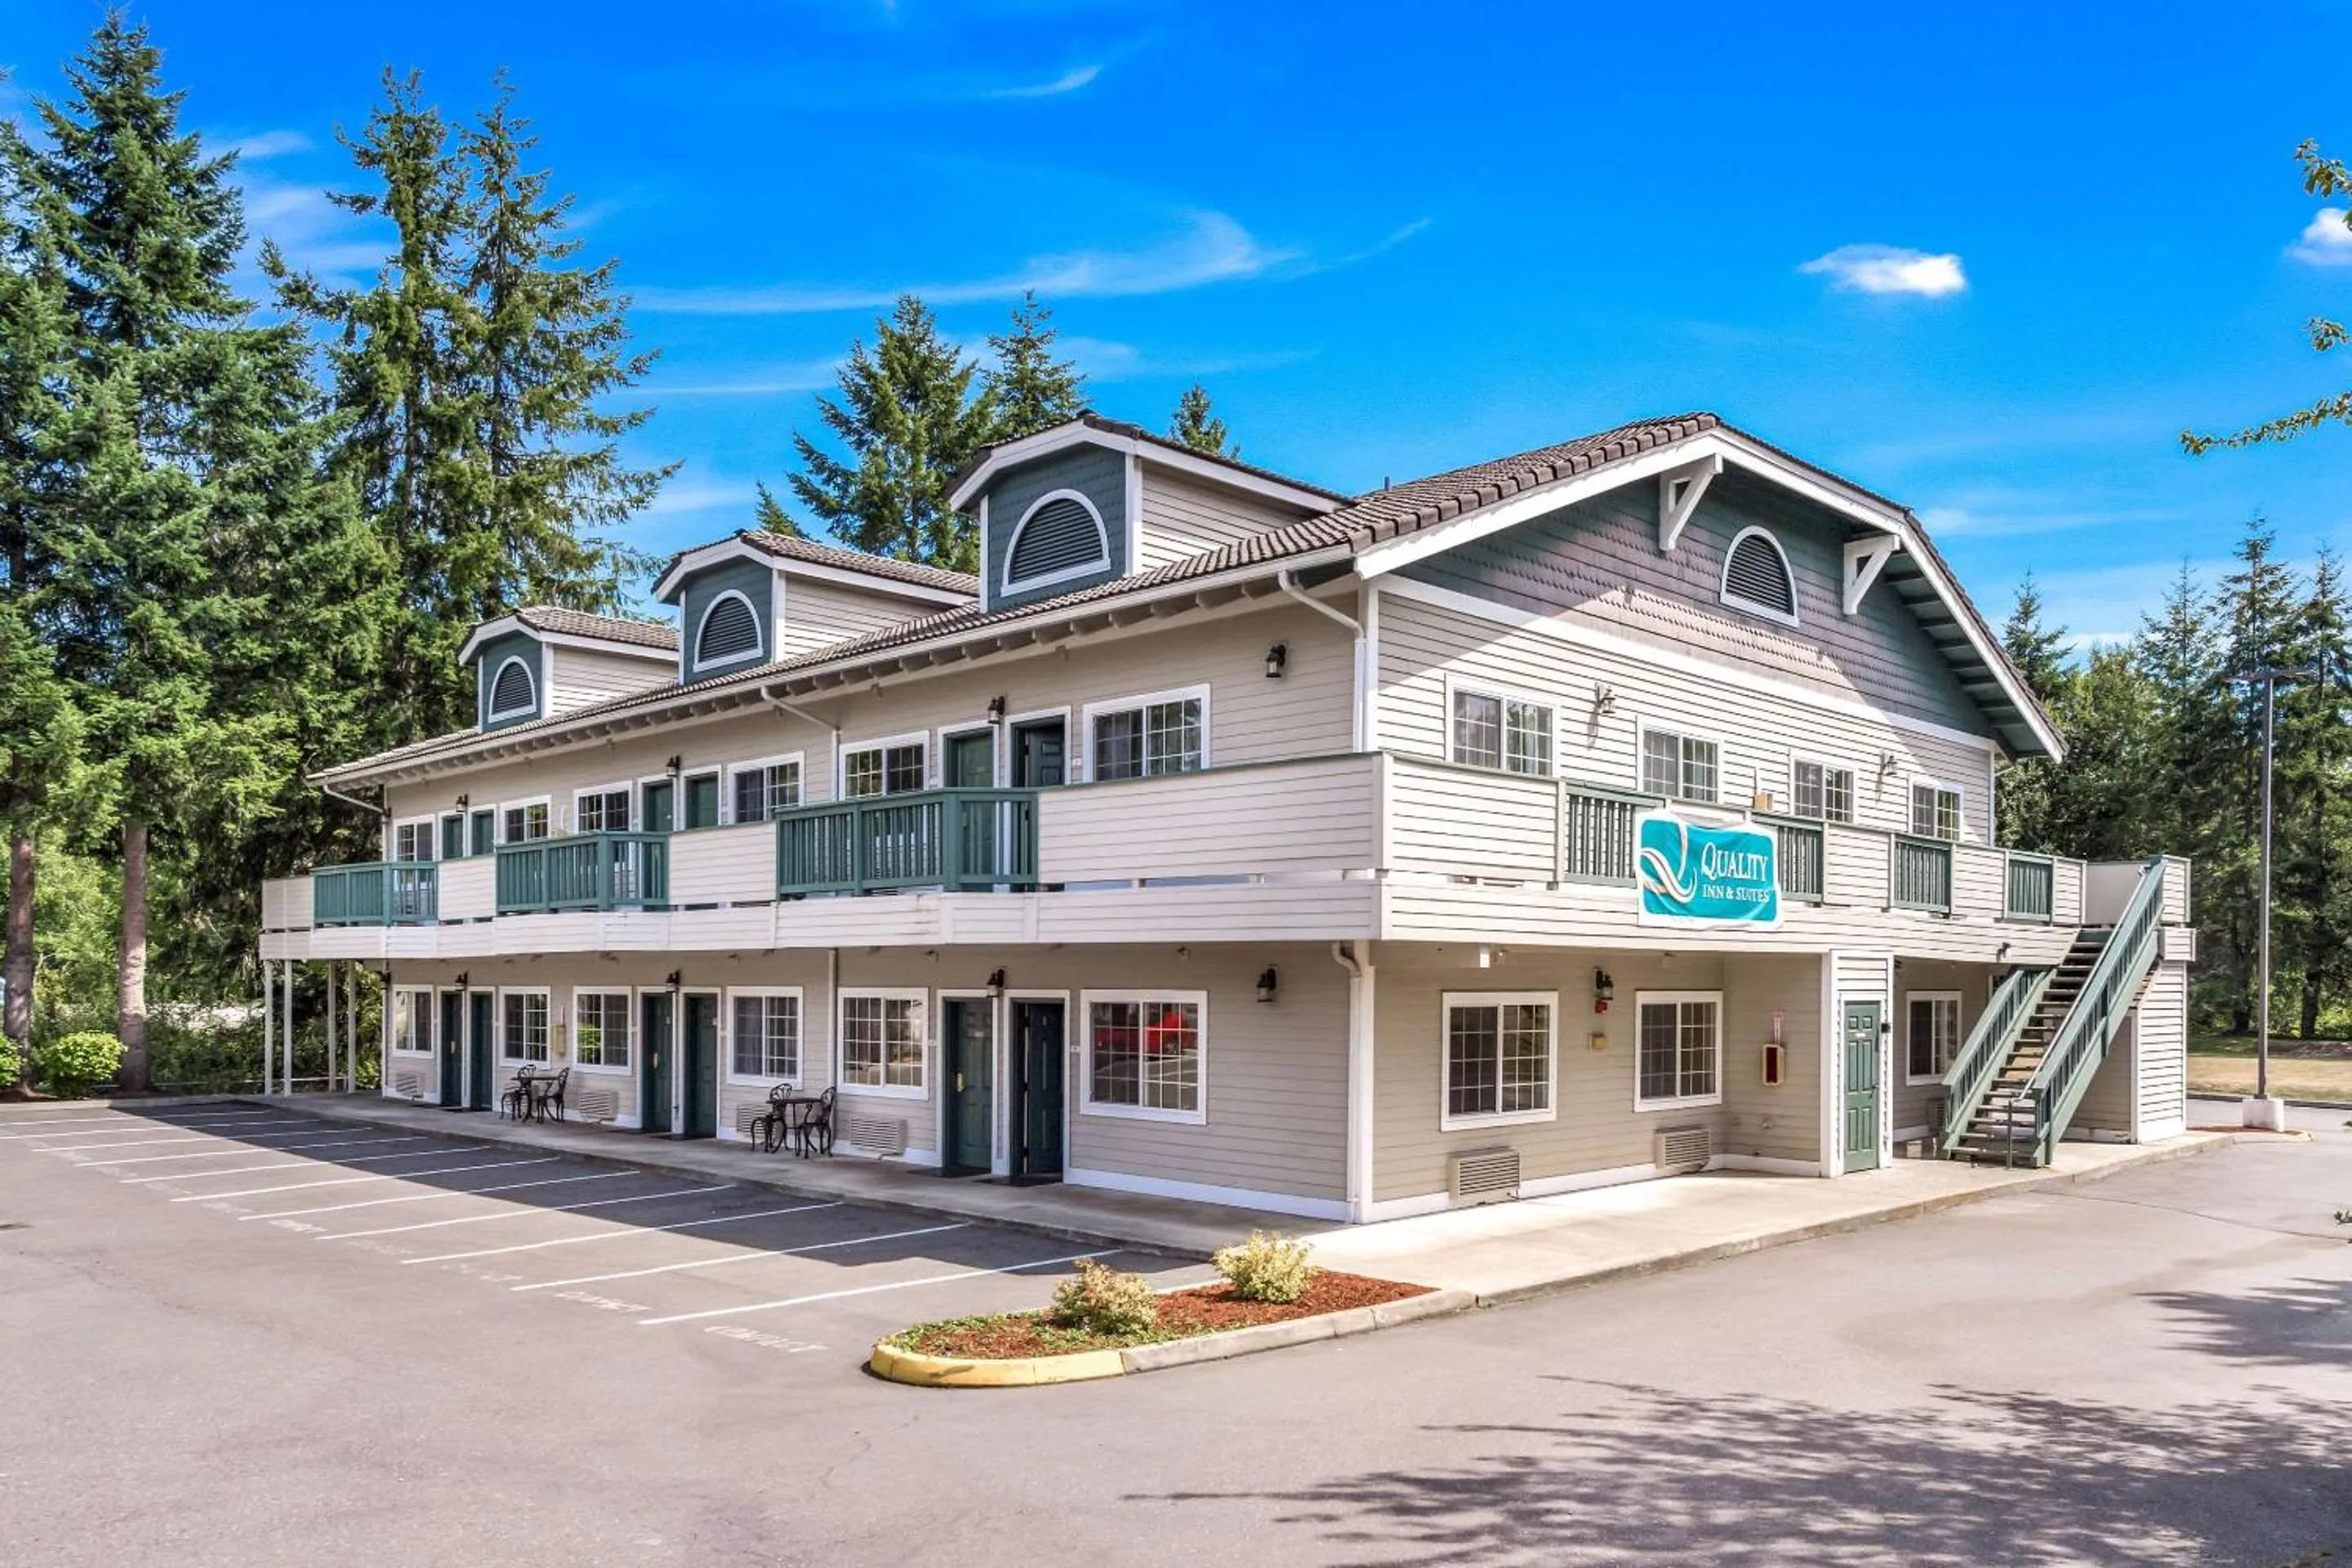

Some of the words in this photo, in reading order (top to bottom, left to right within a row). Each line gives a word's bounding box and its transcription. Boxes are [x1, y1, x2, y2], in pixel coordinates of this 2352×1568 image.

[1701, 842, 1768, 881] QUALITY
[1702, 884, 1725, 899] INN
[1726, 886, 1735, 900] &
[1735, 887, 1771, 902] SUITES
